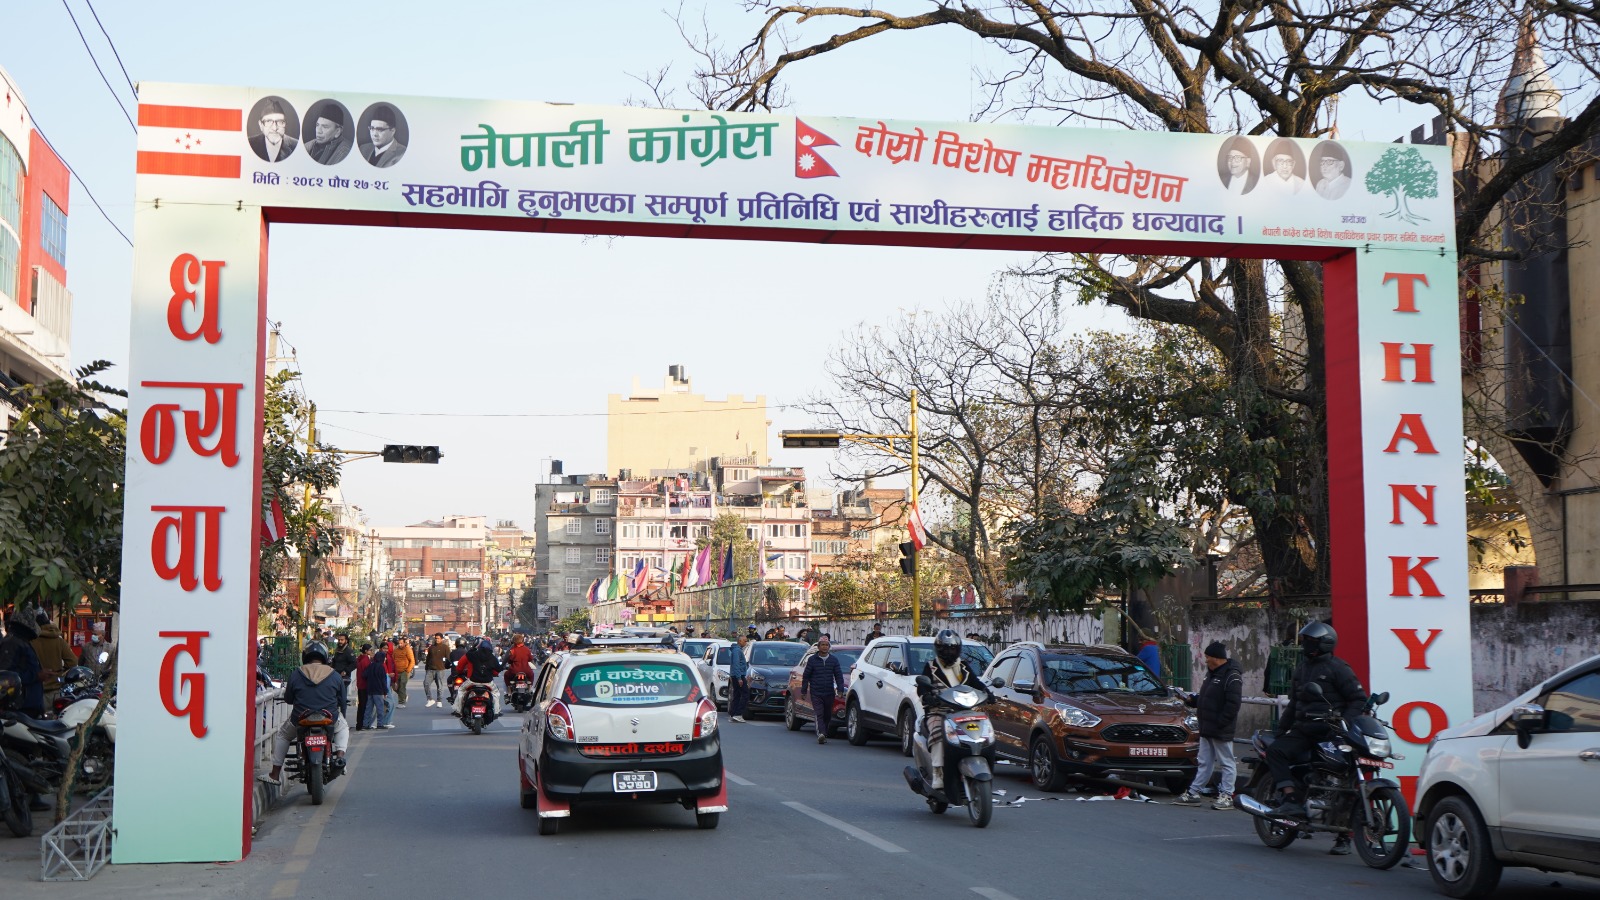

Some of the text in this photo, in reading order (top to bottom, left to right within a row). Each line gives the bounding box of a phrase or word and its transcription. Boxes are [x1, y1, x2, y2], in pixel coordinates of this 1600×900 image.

[460, 114, 780, 172] नेपाली कांग्रेस
[855, 121, 1188, 203] दोस्रो विशेष महाधिवेशन
[252, 171, 281, 185] मिति
[292, 176, 324, 188] २०८२
[328, 175, 350, 189] पौष
[353, 178, 390, 191] २७-२८
[402, 180, 509, 209] सहभागि
[517, 189, 636, 218] हुनुभएका
[645, 191, 729, 223] सम्पूर्ण
[737, 191, 840, 221] प्रतिनिधि
[847, 198, 881, 223] एवं
[1048, 203, 1123, 232] हार्दिक
[1132, 211, 1225, 235] धन्यवाद
[580, 668, 684, 682] माँ चण्डेश्वरी
[565, 686, 577, 703] TAXI
[614, 683, 660, 695] inDrive
[687, 686, 700, 702] TAXI
[584, 743, 639, 755] पशुपती
